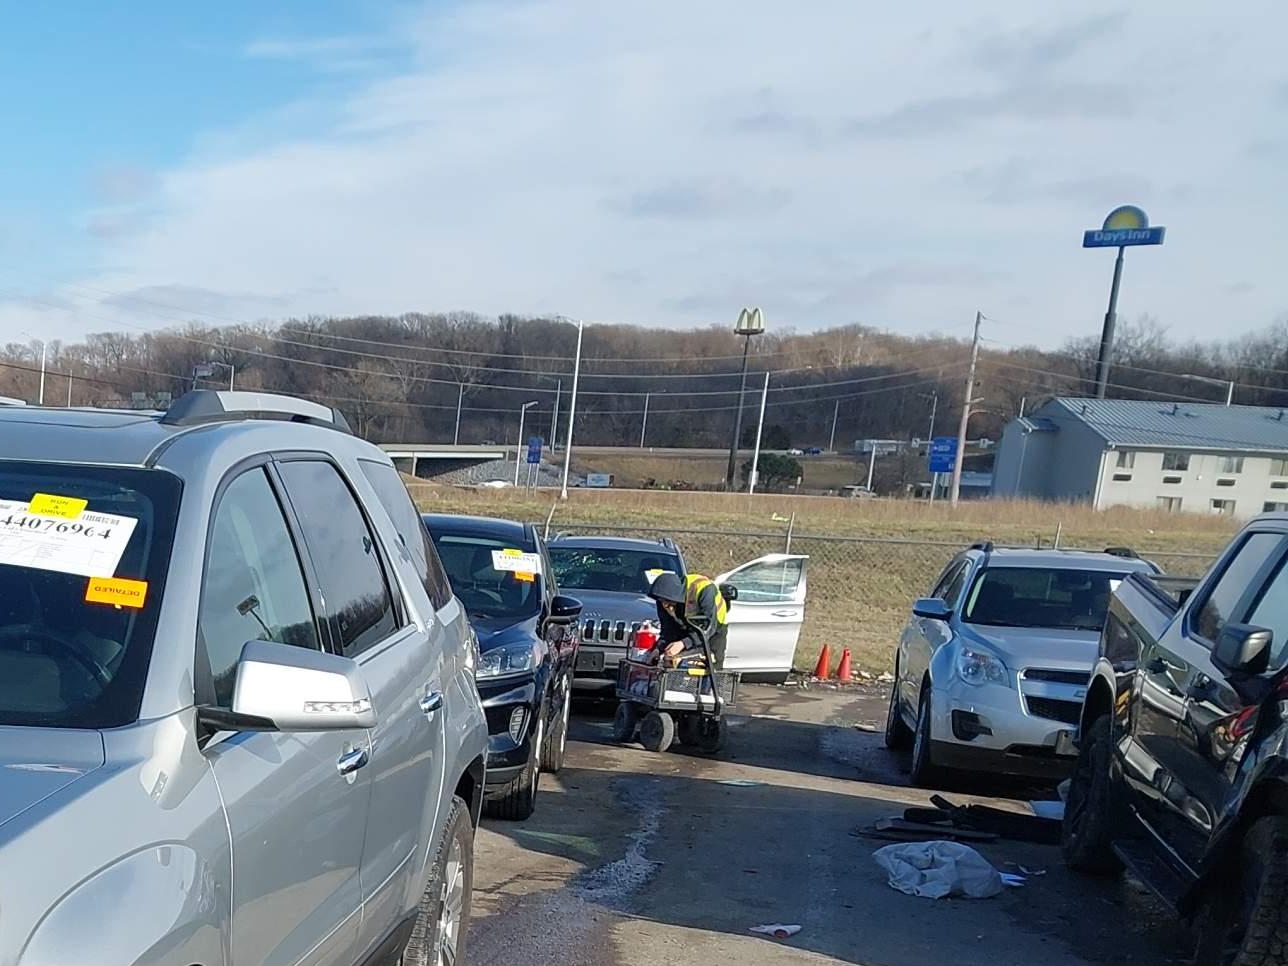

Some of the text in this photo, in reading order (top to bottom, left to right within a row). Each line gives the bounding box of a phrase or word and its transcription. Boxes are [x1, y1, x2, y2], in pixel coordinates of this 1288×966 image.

[1094, 230, 1151, 242] Days Inn
[0, 514, 112, 540] 44076964
[93, 585, 141, 598] DETAILED
